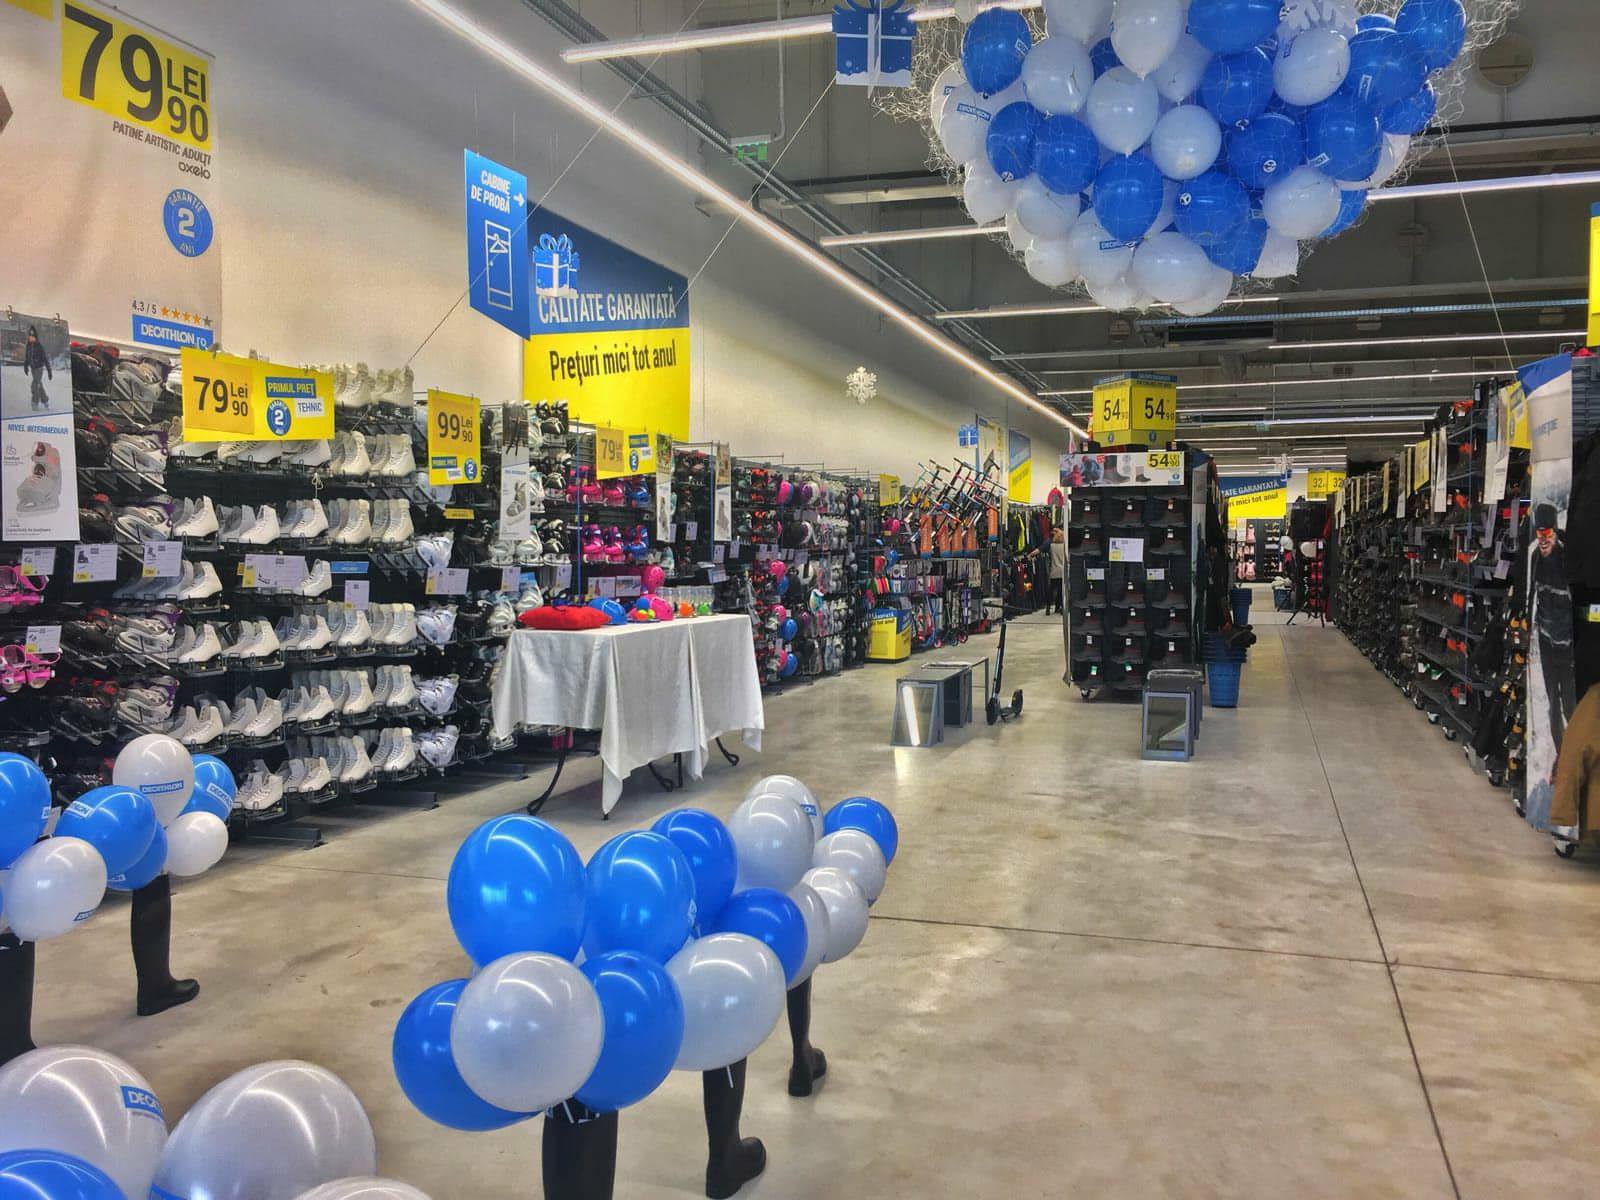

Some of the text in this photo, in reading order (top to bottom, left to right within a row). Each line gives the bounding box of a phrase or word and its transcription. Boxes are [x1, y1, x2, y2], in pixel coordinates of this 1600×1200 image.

[65, 3, 163, 122] 79
[167, 58, 207, 102] LEI
[168, 95, 209, 143] 90
[113, 121, 143, 141] PATINE
[145, 133, 180, 155] ARTISTIC
[178, 161, 211, 179] oxelo
[471, 184, 482, 202] DE
[178, 207, 195, 238] 2
[537, 286, 677, 324] CALITATE GARANTATĂ
[603, 343, 630, 372] mici
[632, 348, 651, 371] tot
[653, 339, 677, 367] anul
[193, 376, 229, 413] 79
[231, 382, 248, 399] Lei
[268, 383, 295, 392] PRIMUL
[232, 400, 248, 417] 90
[275, 409, 284, 426] 2
[298, 402, 322, 412] TEHNIC
[1104, 399, 1121, 421] 54
[1145, 398, 1165, 419] 54
[437, 412, 460, 440] 99
[461, 417, 472, 428] Lei
[462, 432, 473, 443] 90
[600, 439, 616, 460] 79
[468, 464, 474, 474] 2
[1149, 453, 1169, 468] 54
